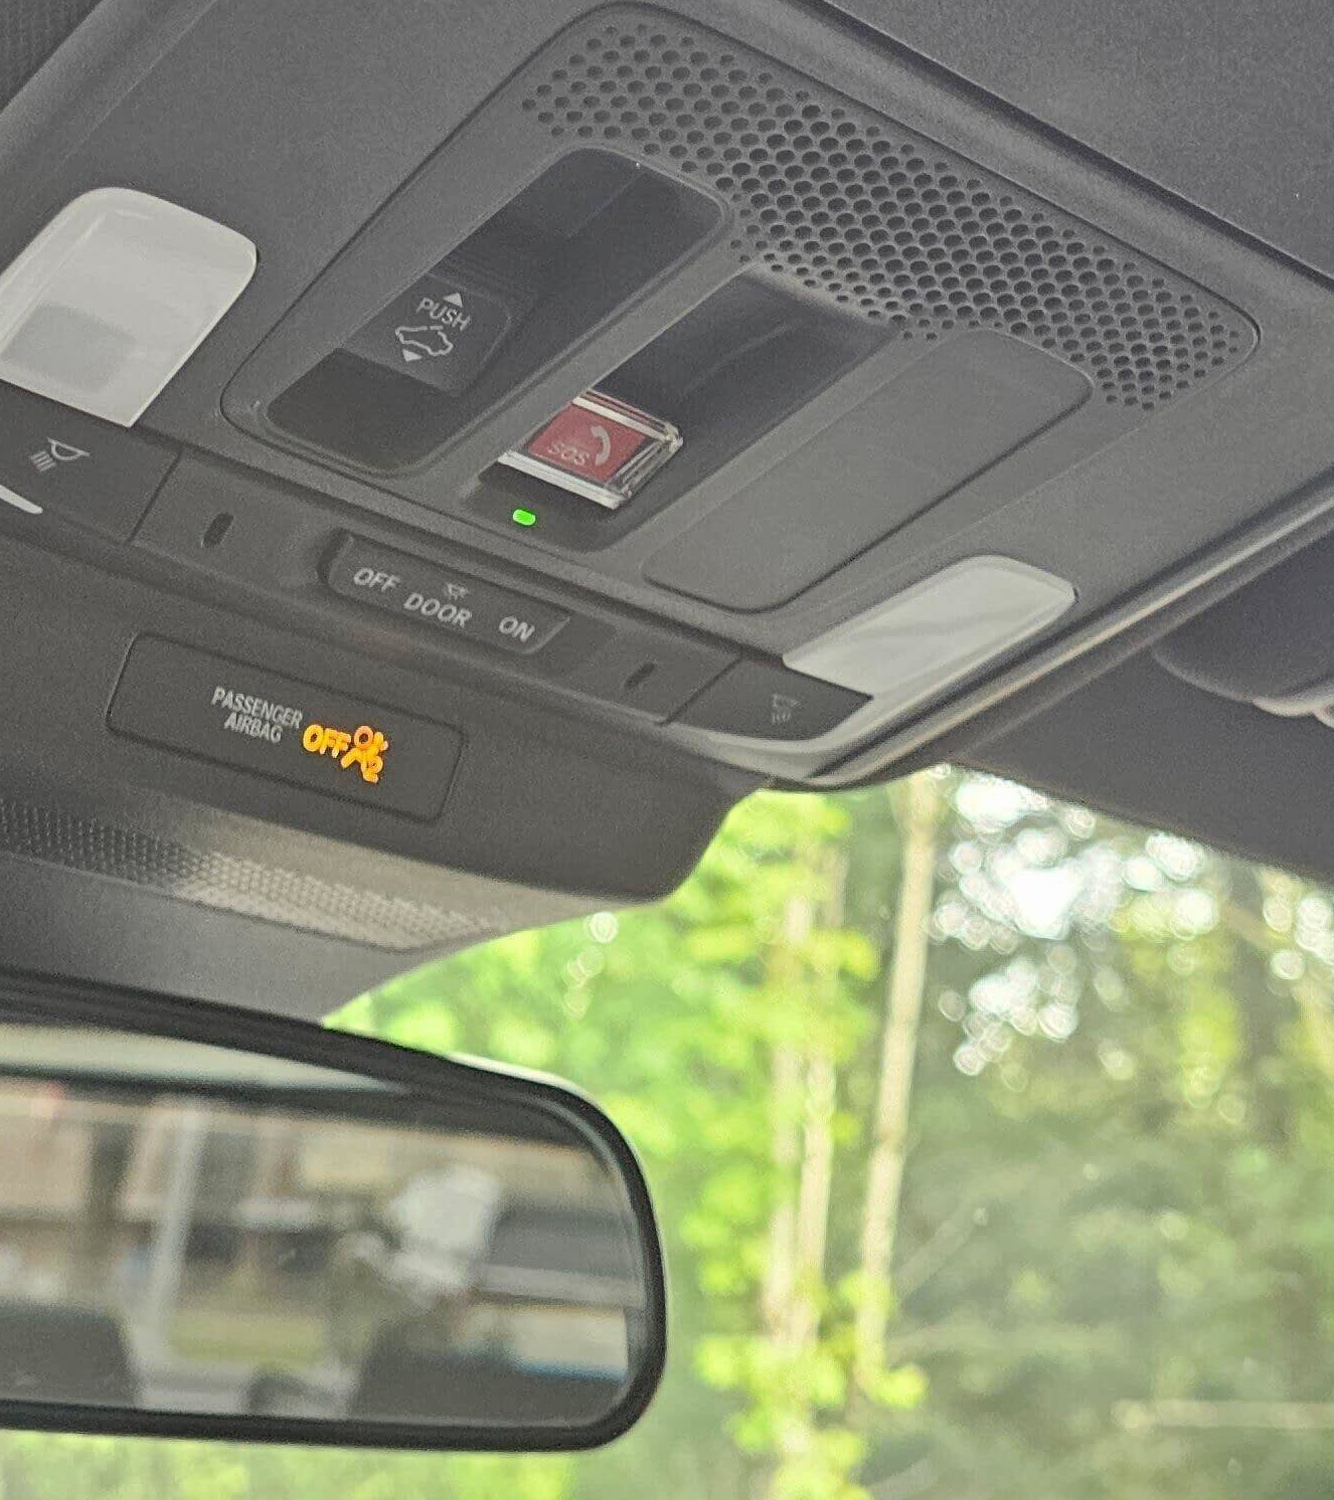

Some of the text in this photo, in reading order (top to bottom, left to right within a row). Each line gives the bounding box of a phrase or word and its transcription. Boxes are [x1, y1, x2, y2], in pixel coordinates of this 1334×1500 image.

[417, 297, 471, 332] PUSH
[547, 442, 591, 467] SOS
[353, 566, 402, 594] OFF
[403, 592, 473, 629] DOOR
[498, 615, 535, 643] ON
[211, 685, 304, 730] PASSENGER
[223, 710, 284, 745] AIRBAG
[302, 723, 352, 759] OFF
